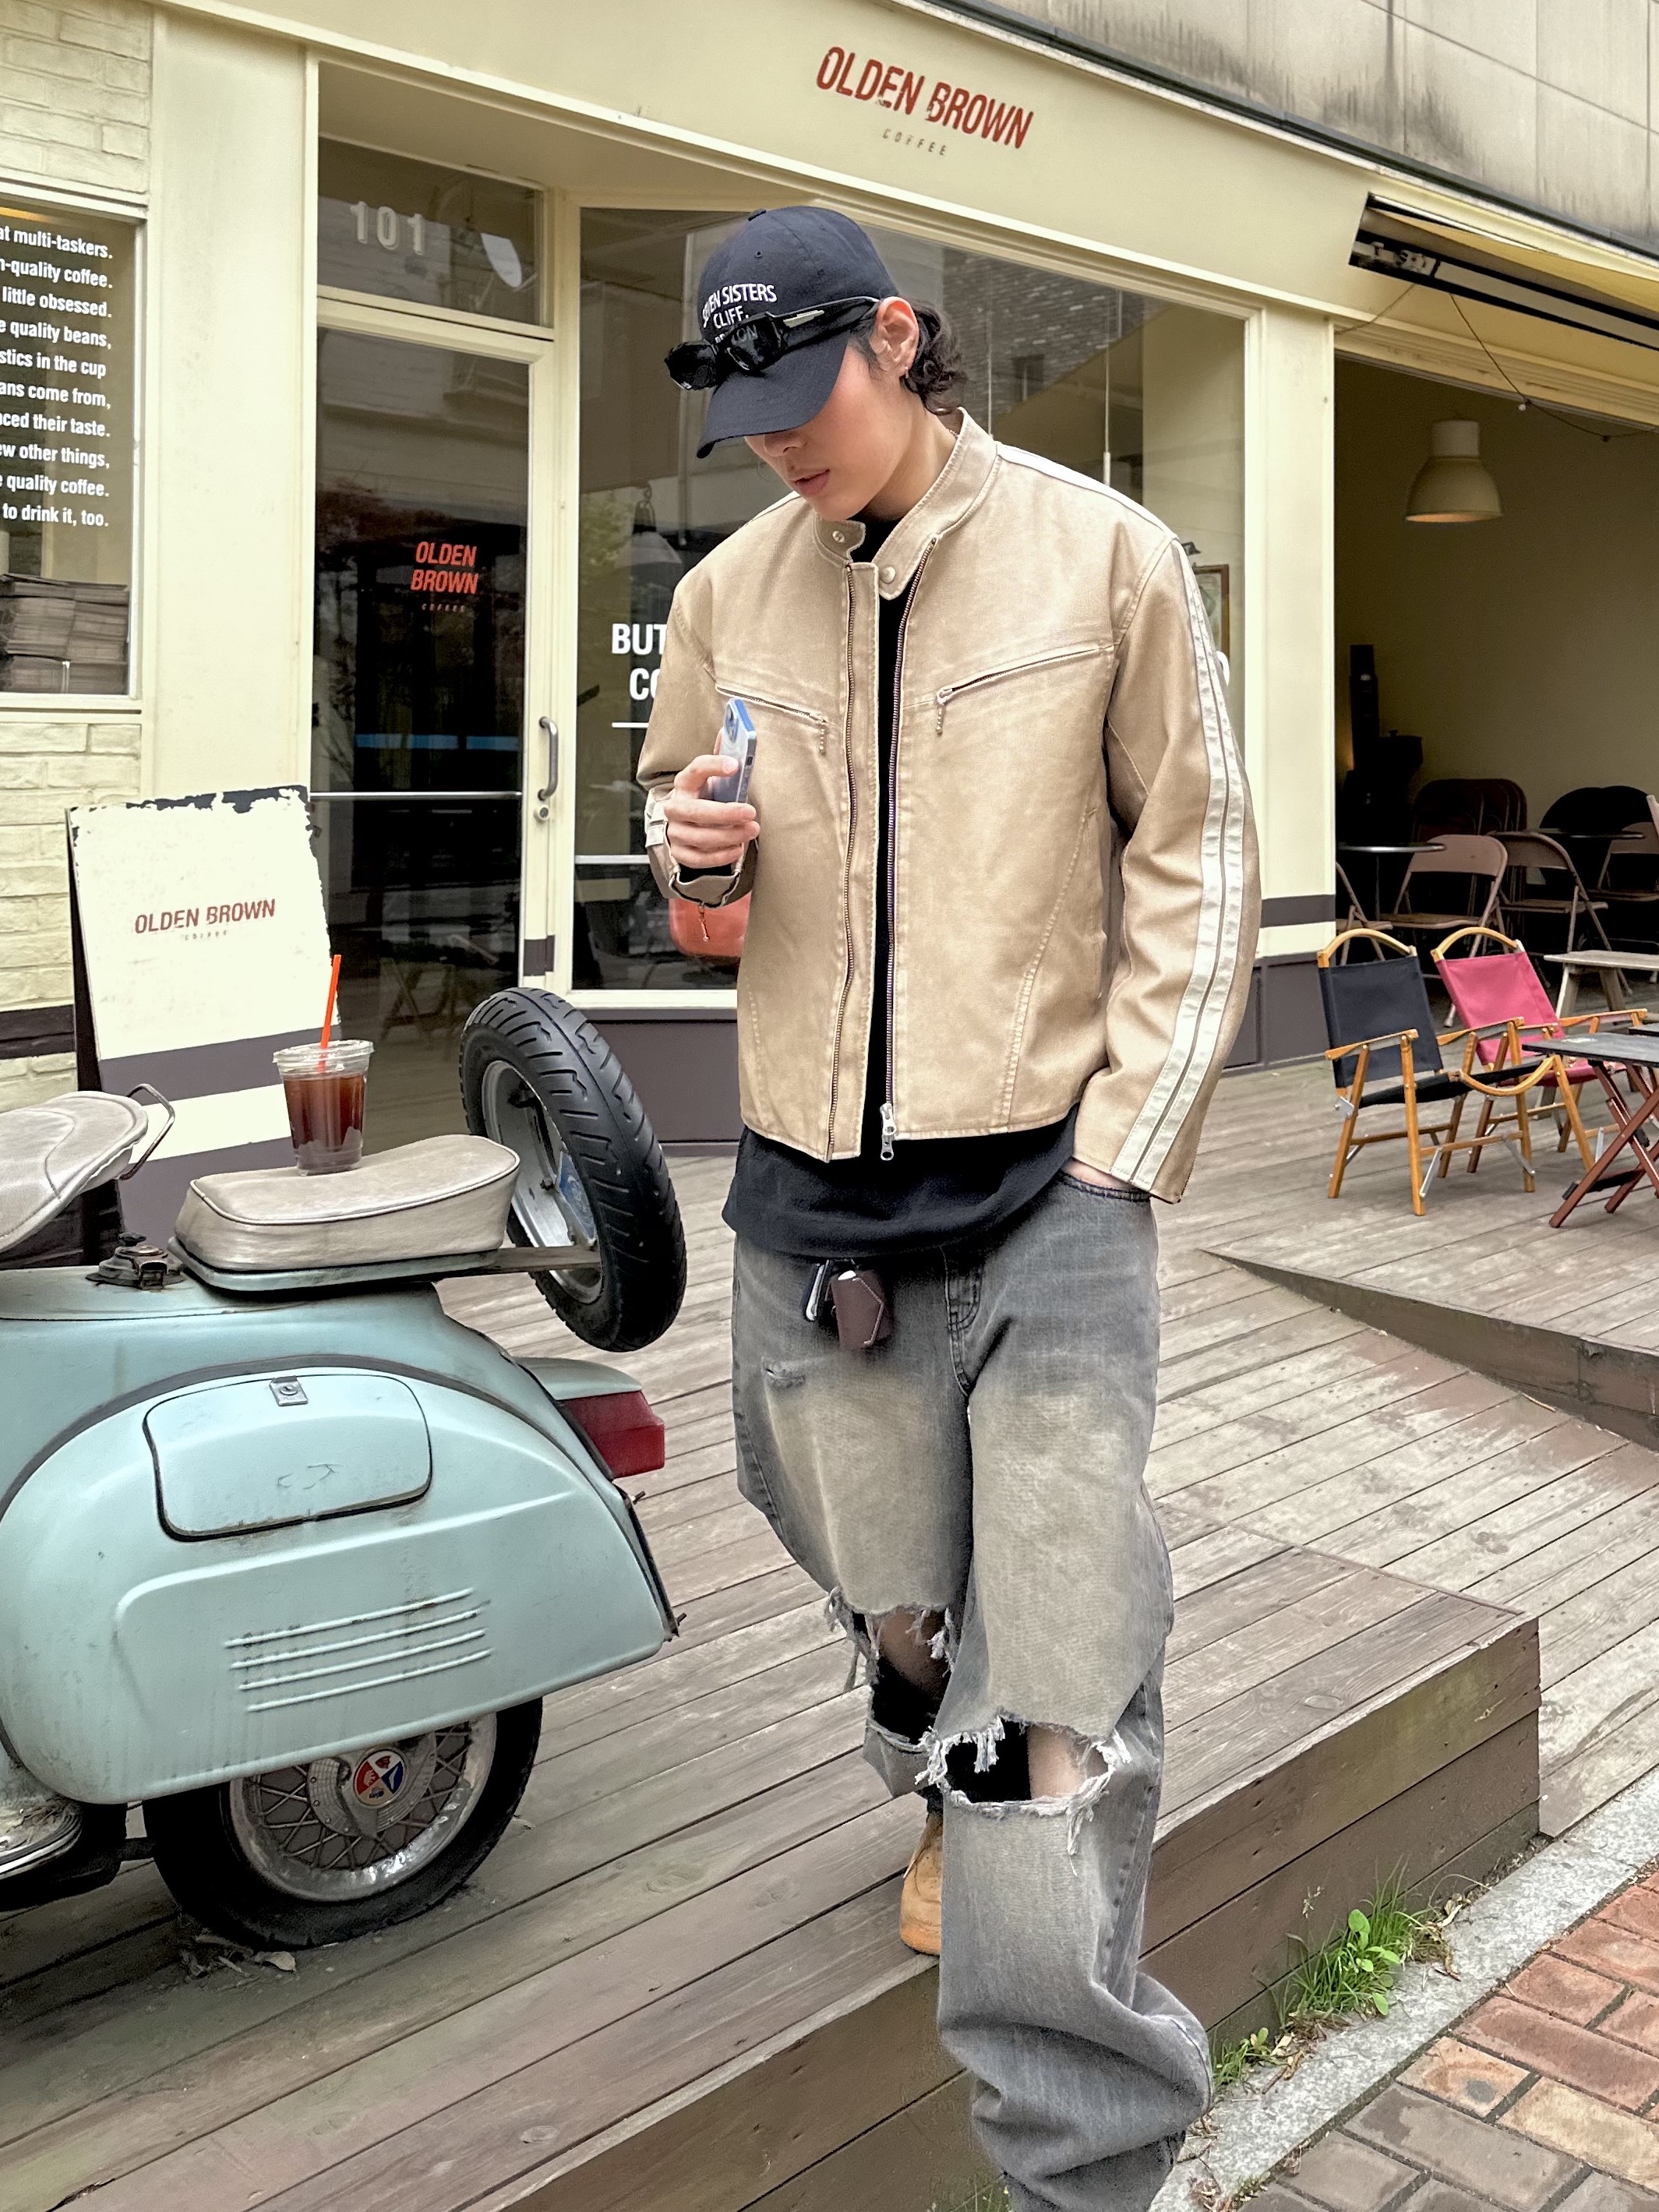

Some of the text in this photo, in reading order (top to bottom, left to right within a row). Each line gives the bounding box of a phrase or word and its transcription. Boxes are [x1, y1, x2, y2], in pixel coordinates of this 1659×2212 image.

[817, 47, 1034, 149] OLDEN BROWN
[350, 200, 425, 256] 101
[13, 230, 113, 259] multi-taskers.
[64, 268, 113, 288] coffee.
[2, 286, 112, 318] little obsessed.
[722, 283, 778, 305] SISTERS
[713, 305, 749, 329] CLIFF.
[10, 321, 60, 343] quality
[64, 326, 111, 350] beans,
[0, 349, 107, 379] stics in the cup
[28, 385, 69, 403] come
[72, 387, 111, 410] from,
[33, 414, 68, 432] their
[70, 418, 111, 437] taste.
[19, 444, 58, 461] other
[61, 447, 110, 469] things,
[6, 475, 57, 496] quality
[61, 478, 110, 497] coffee.
[2, 503, 109, 527] to drink it, too.
[415, 541, 477, 567] OLDEN
[410, 569, 479, 594] BROWN
[135, 898, 276, 934] OLDEN BROWN
